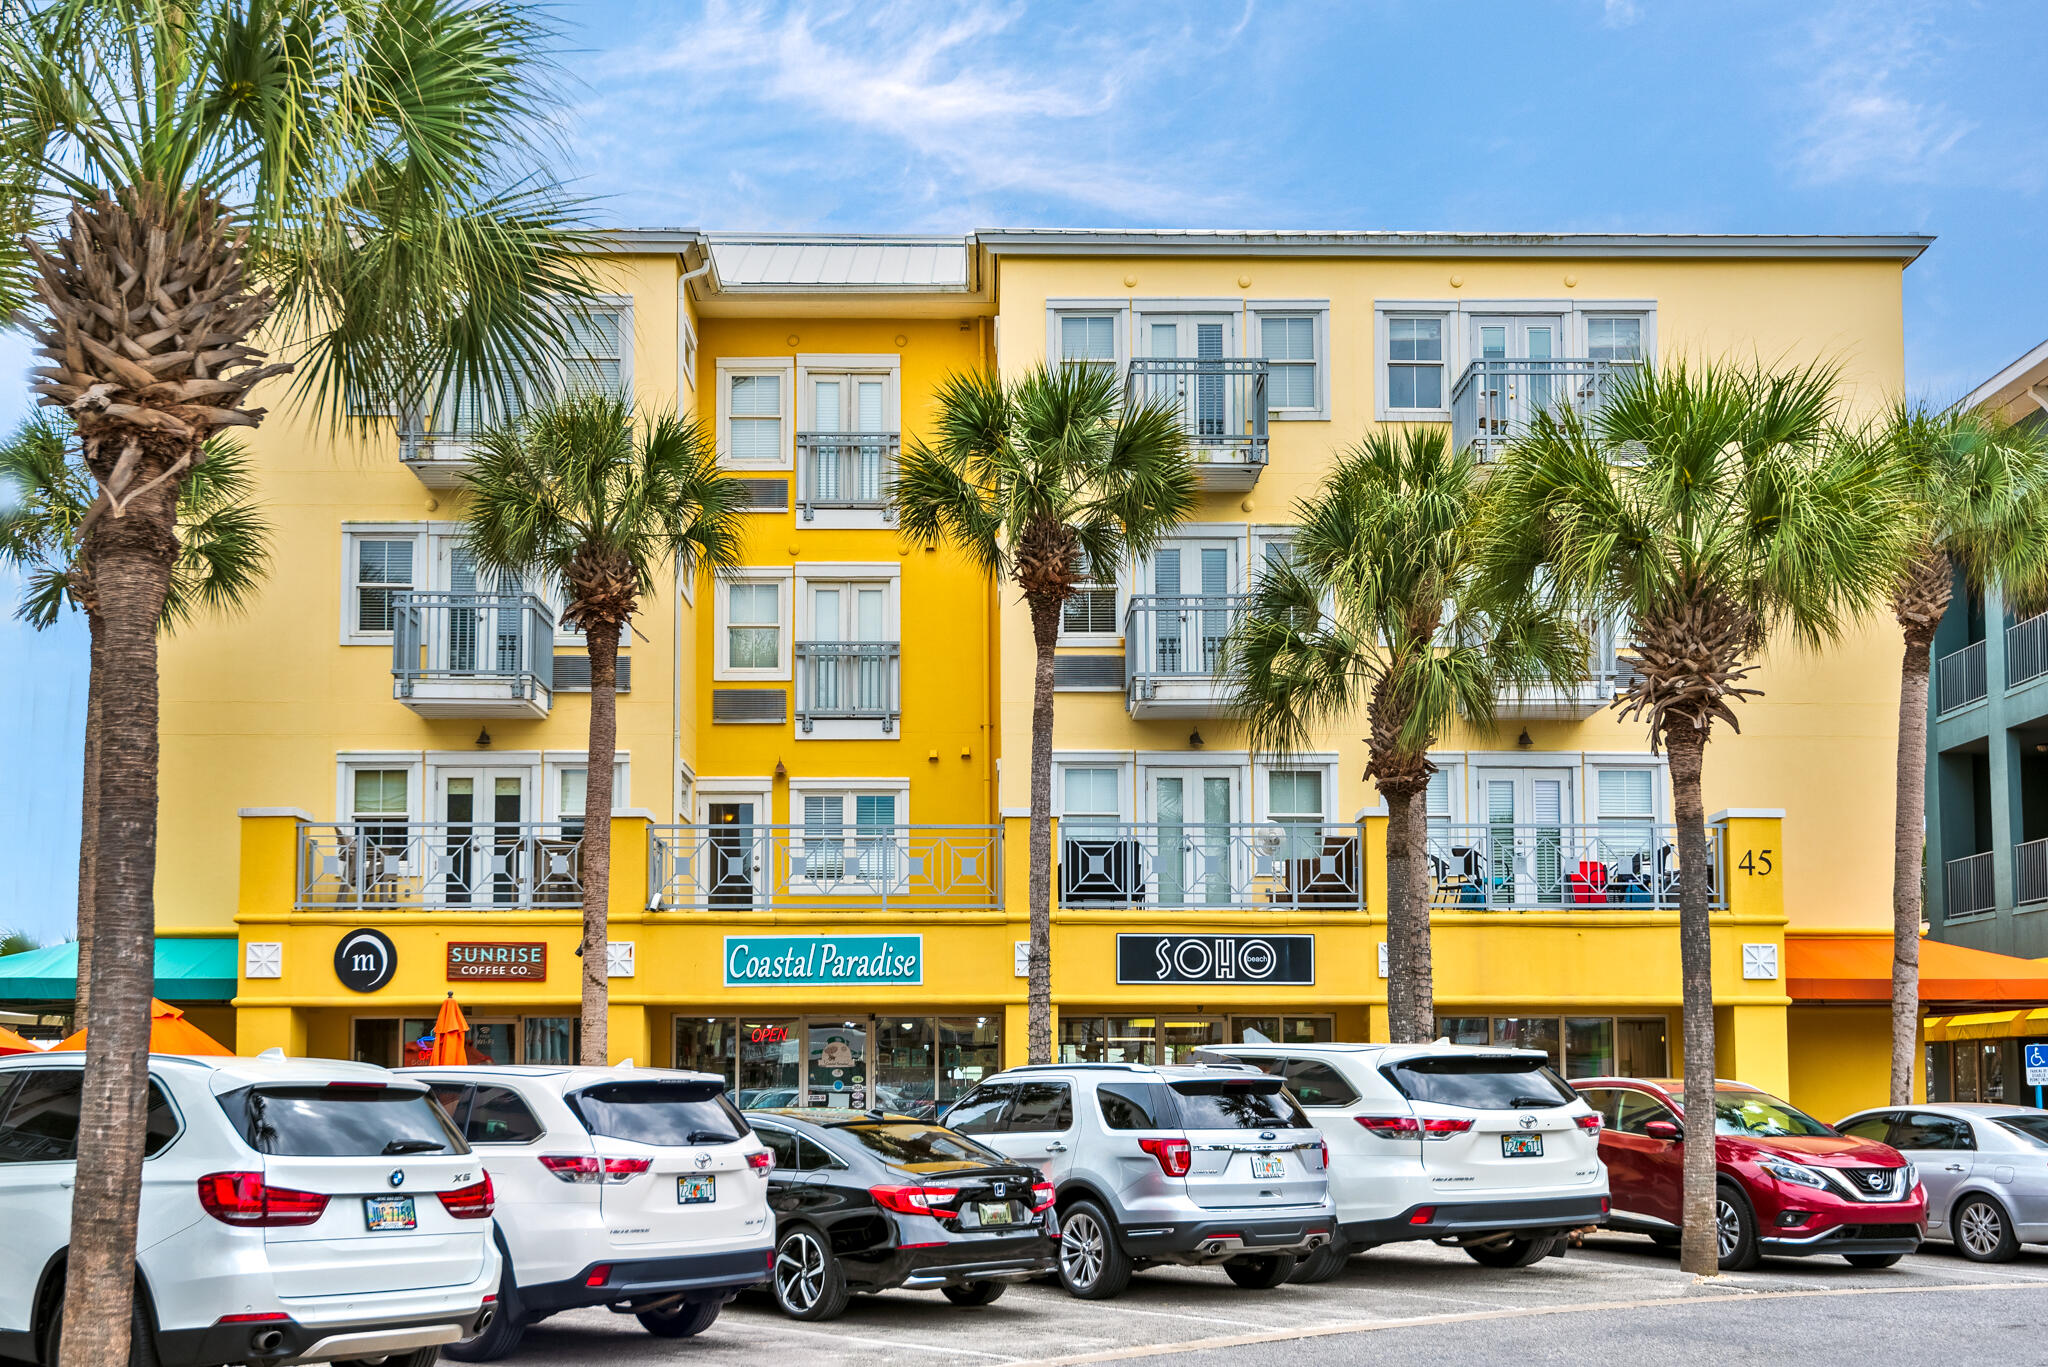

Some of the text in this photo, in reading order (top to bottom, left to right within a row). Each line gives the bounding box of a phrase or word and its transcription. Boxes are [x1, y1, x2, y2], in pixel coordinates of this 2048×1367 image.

[1738, 849, 1772, 876] 45
[352, 954, 376, 971] m
[452, 947, 541, 962] SUNRISE
[729, 943, 916, 979] Coastal Paradise
[1155, 938, 1277, 980] SOHO
[1247, 955, 1268, 963] beach
[461, 965, 531, 975] COFFEE CO.
[751, 1028, 789, 1043] OPEN
